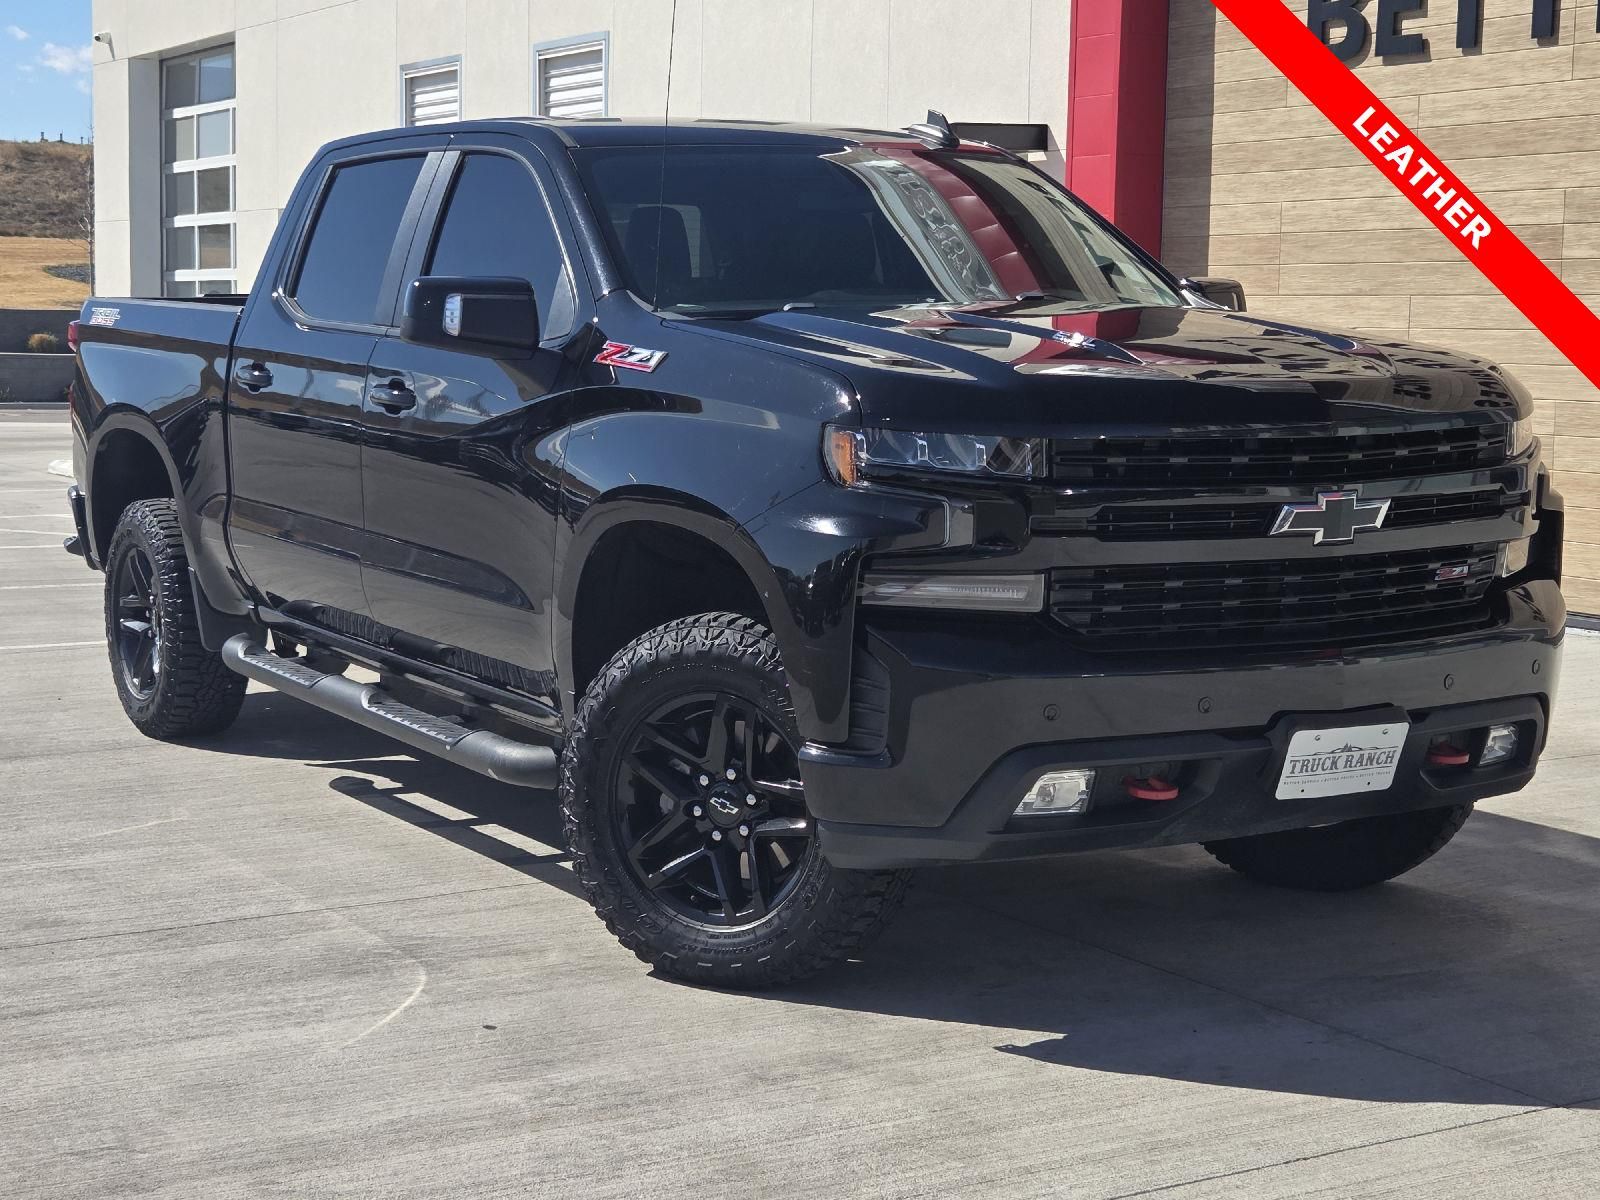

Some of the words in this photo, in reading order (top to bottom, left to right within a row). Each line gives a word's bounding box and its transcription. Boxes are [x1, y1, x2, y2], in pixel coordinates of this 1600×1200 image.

[592, 340, 669, 373] Z71
[1434, 566, 1469, 580] Z71
[1289, 755, 1342, 775] TRUCK
[1343, 749, 1397, 770] RANCH
